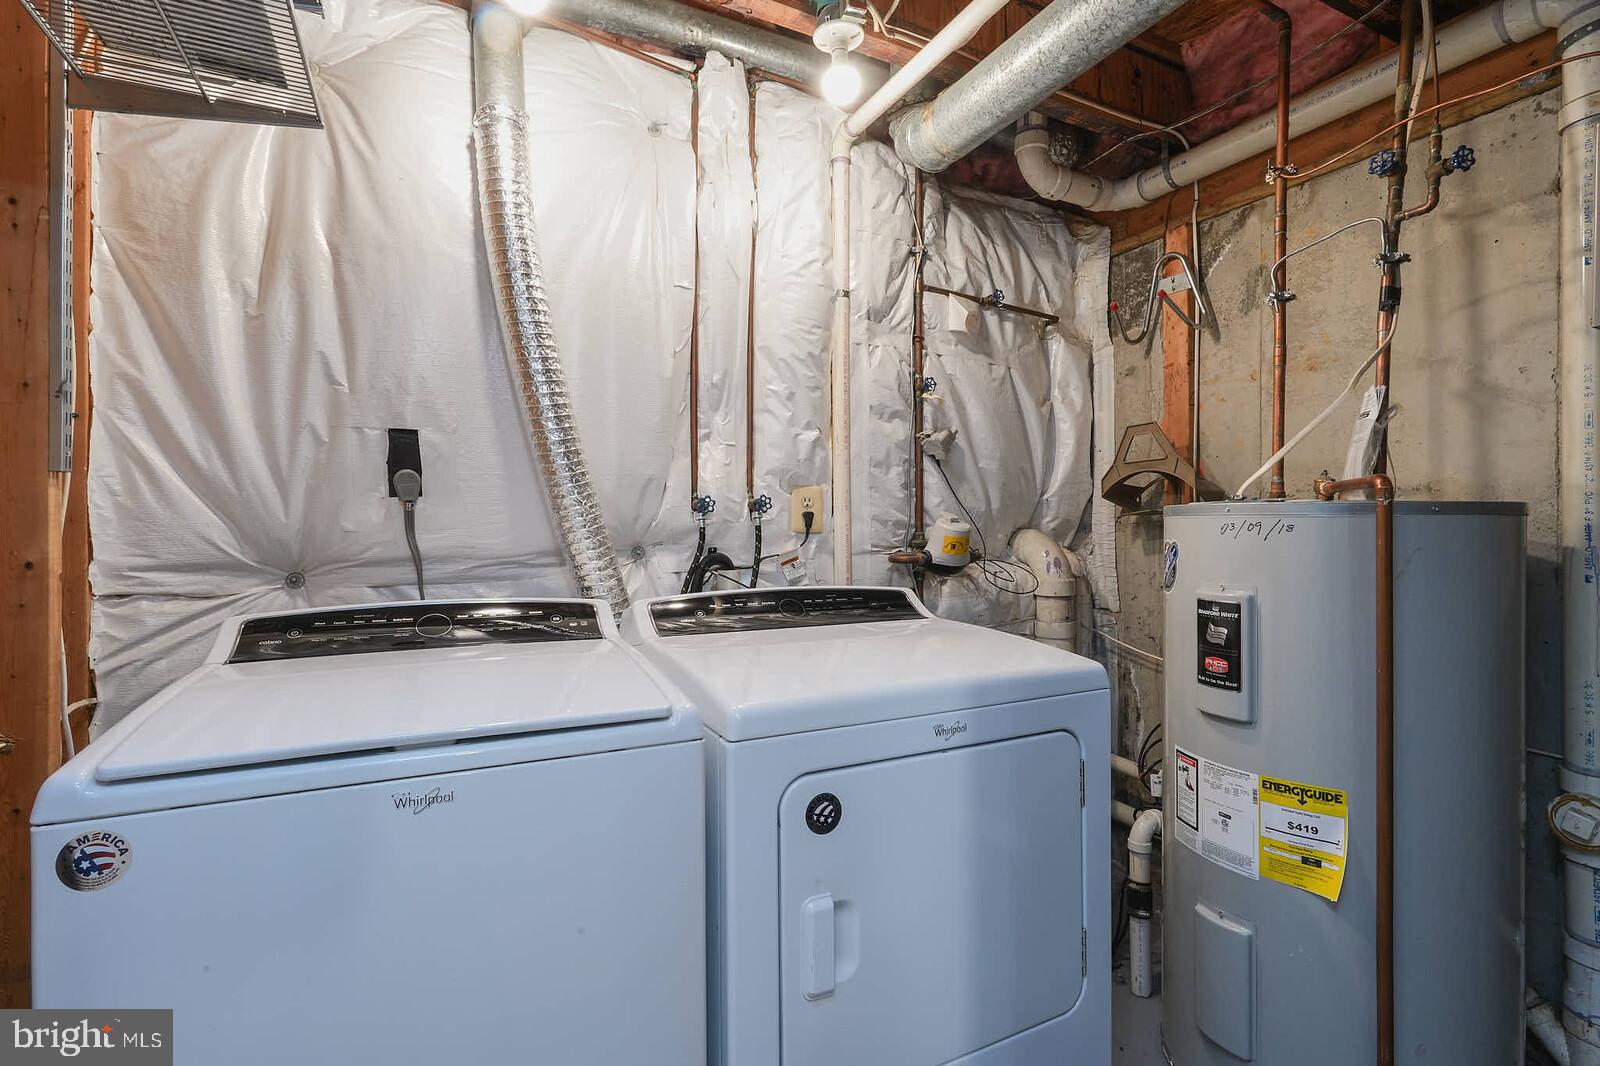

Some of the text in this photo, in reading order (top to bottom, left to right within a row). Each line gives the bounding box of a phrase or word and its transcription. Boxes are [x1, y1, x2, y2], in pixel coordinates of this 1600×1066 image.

[934, 721, 967, 739] Whirlpool
[393, 788, 455, 813] Whirlpool
[67, 832, 129, 856] AMERICA
